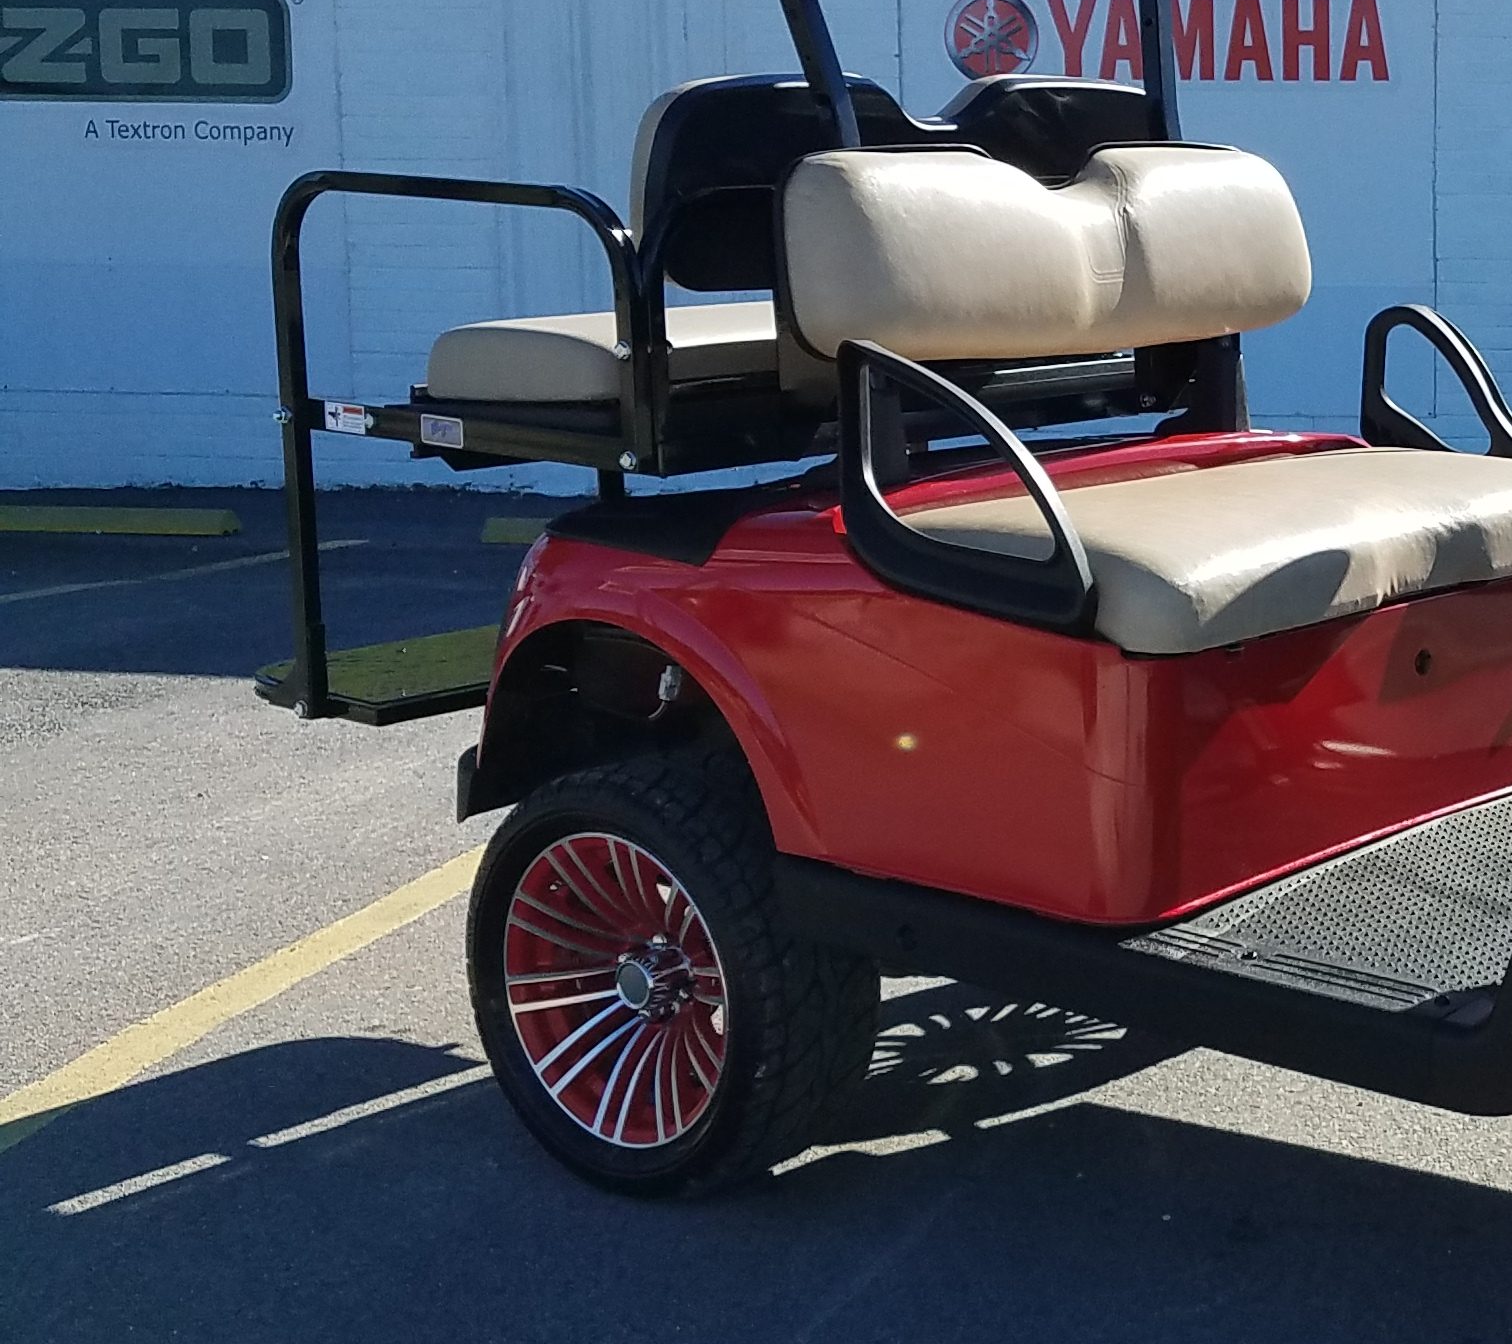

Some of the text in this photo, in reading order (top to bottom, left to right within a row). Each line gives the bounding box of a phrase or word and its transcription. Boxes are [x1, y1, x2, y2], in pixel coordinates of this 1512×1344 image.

[84, 119, 295, 147] A Textron Company
